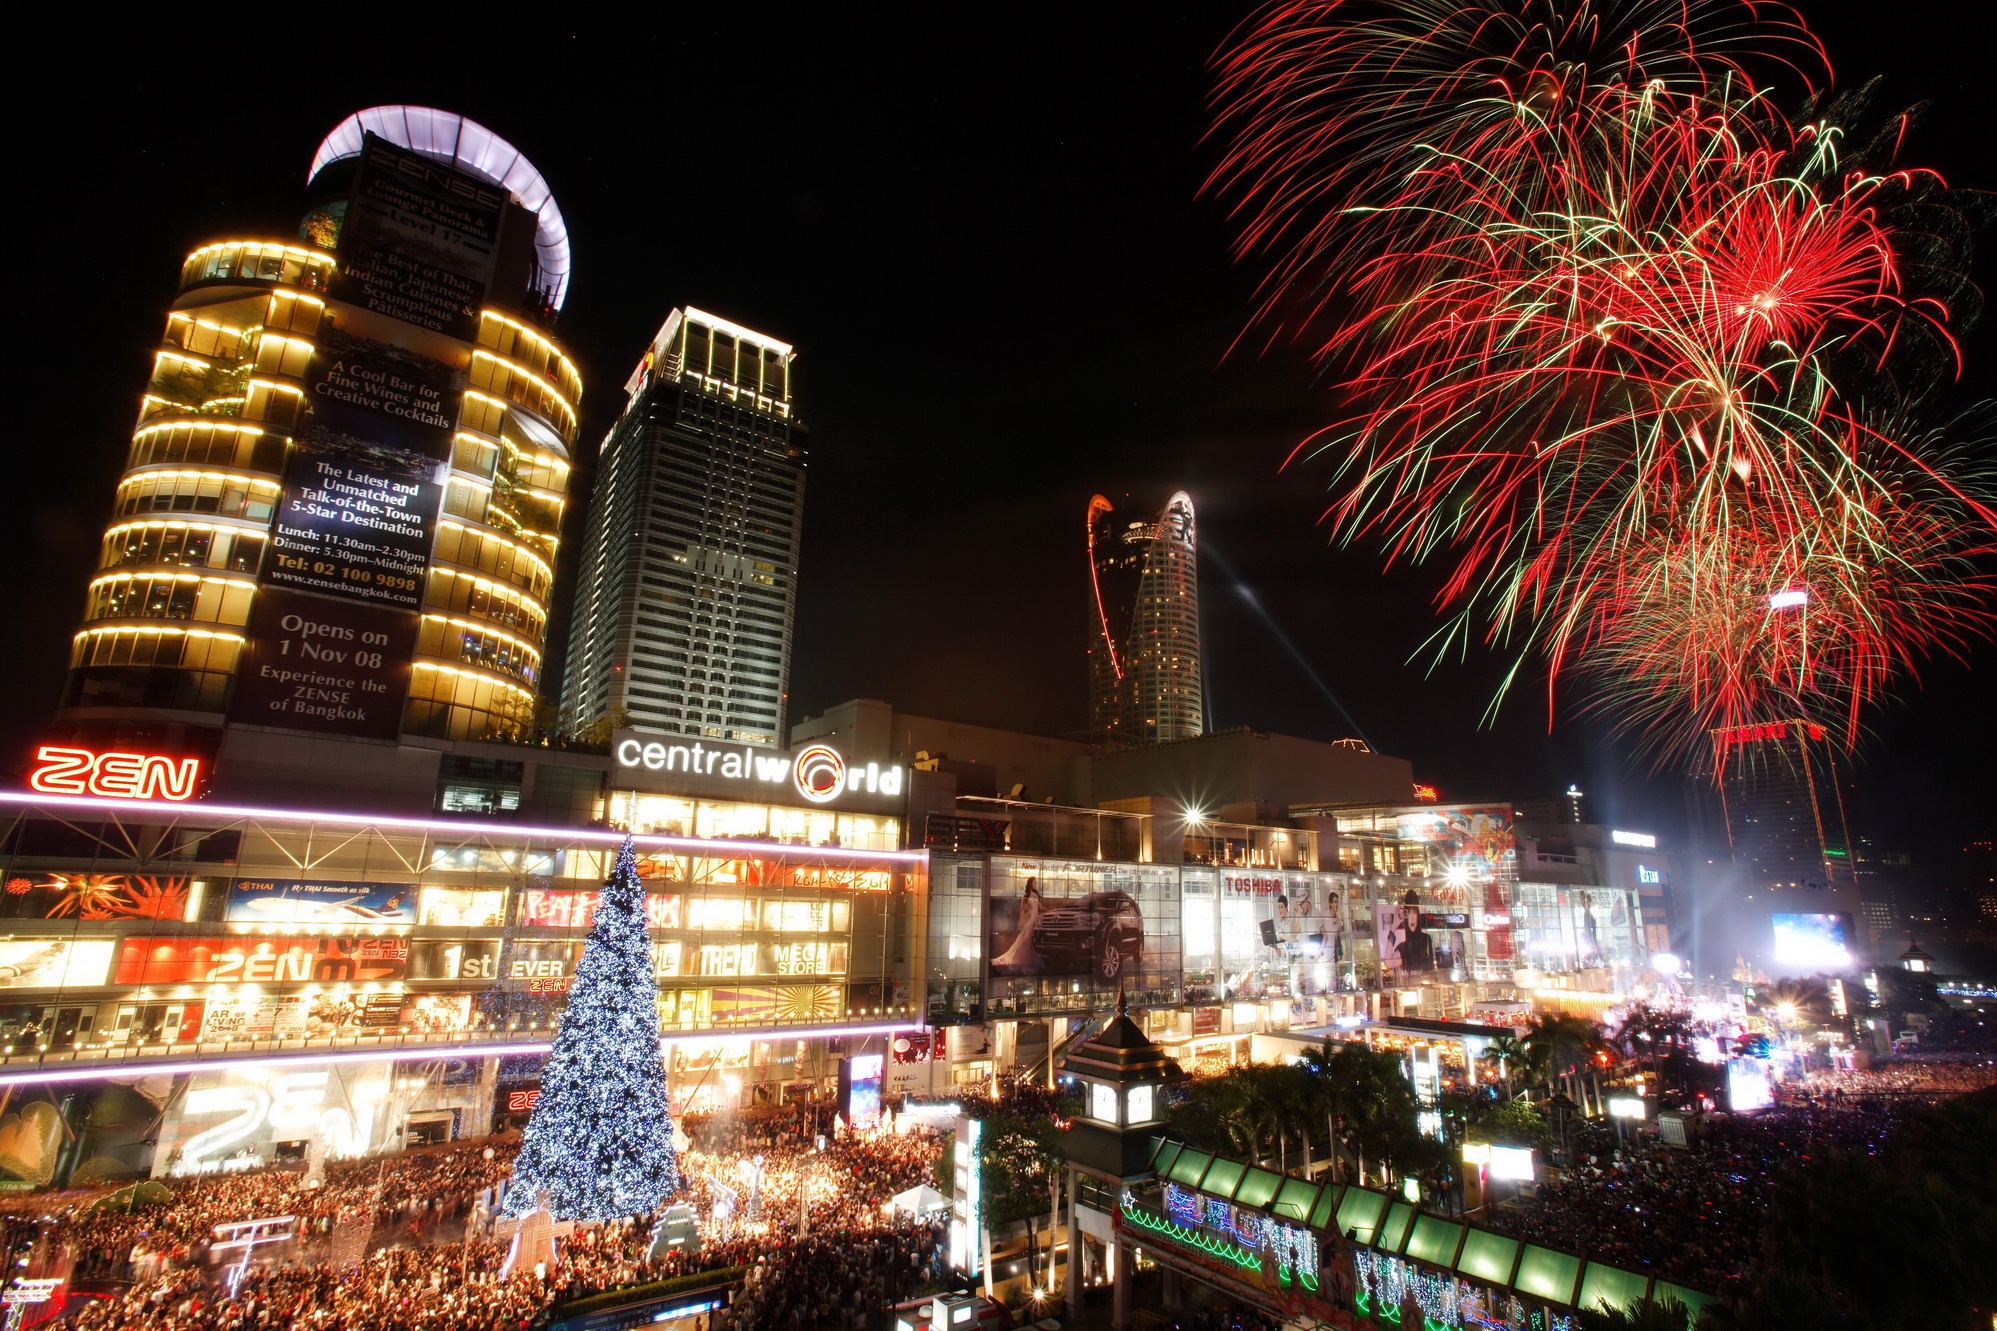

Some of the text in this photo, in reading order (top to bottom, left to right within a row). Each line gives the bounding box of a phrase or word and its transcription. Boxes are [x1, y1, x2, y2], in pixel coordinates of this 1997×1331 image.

[368, 145, 501, 210] ZENSE
[367, 186, 490, 239] Lounge Panorama
[374, 179, 487, 228] Gourmet Deck &
[390, 209, 465, 244] Level 17
[344, 264, 474, 317] Indian Cuisines &
[388, 253, 419, 272] Best
[423, 268, 441, 281] of
[442, 271, 475, 294] Thai,
[406, 272, 474, 306] Japanese,
[362, 282, 452, 322] Scrumptious
[327, 370, 441, 413] Fine Wines and
[332, 360, 440, 399] A Cool Bar for
[314, 381, 450, 429] Creative Cocktails
[316, 461, 420, 497] The Latest and
[323, 477, 408, 508] Unmatched
[290, 500, 424, 539] 5-Star Destination
[301, 486, 422, 524] Talk-of-the-Town
[273, 536, 320, 555] Dinner:
[277, 523, 320, 541] Lunch:
[271, 570, 418, 604] www.zensebangkok.com
[277, 553, 416, 591] Tel: 02 100 9898
[280, 614, 389, 646] Opens on
[279, 639, 383, 669] 1 Nov 08
[260, 664, 387, 693] Experience the
[293, 685, 351, 705] ZENSE
[269, 698, 367, 721] of Bangkok
[30, 746, 199, 801] ZEN
[1021, 862, 1037, 870] New
[250, 882, 274, 891] THAI
[291, 884, 303, 893] Fly
[303, 885, 322, 893] THAI
[322, 885, 348, 894] Smooth
[358, 886, 371, 894] silk
[1225, 877, 1282, 893] TOSHIBA
[206, 953, 313, 982] ZEN
[443, 944, 491, 979] 1st
[511, 960, 564, 977] EVER
[700, 944, 758, 976] TREND
[774, 943, 828, 962] MEGA
[777, 961, 825, 975] STORE
[530, 979, 567, 991] ZEN
[508, 1091, 541, 1112] ZE
[584, 1315, 609, 1326] WELCOME
